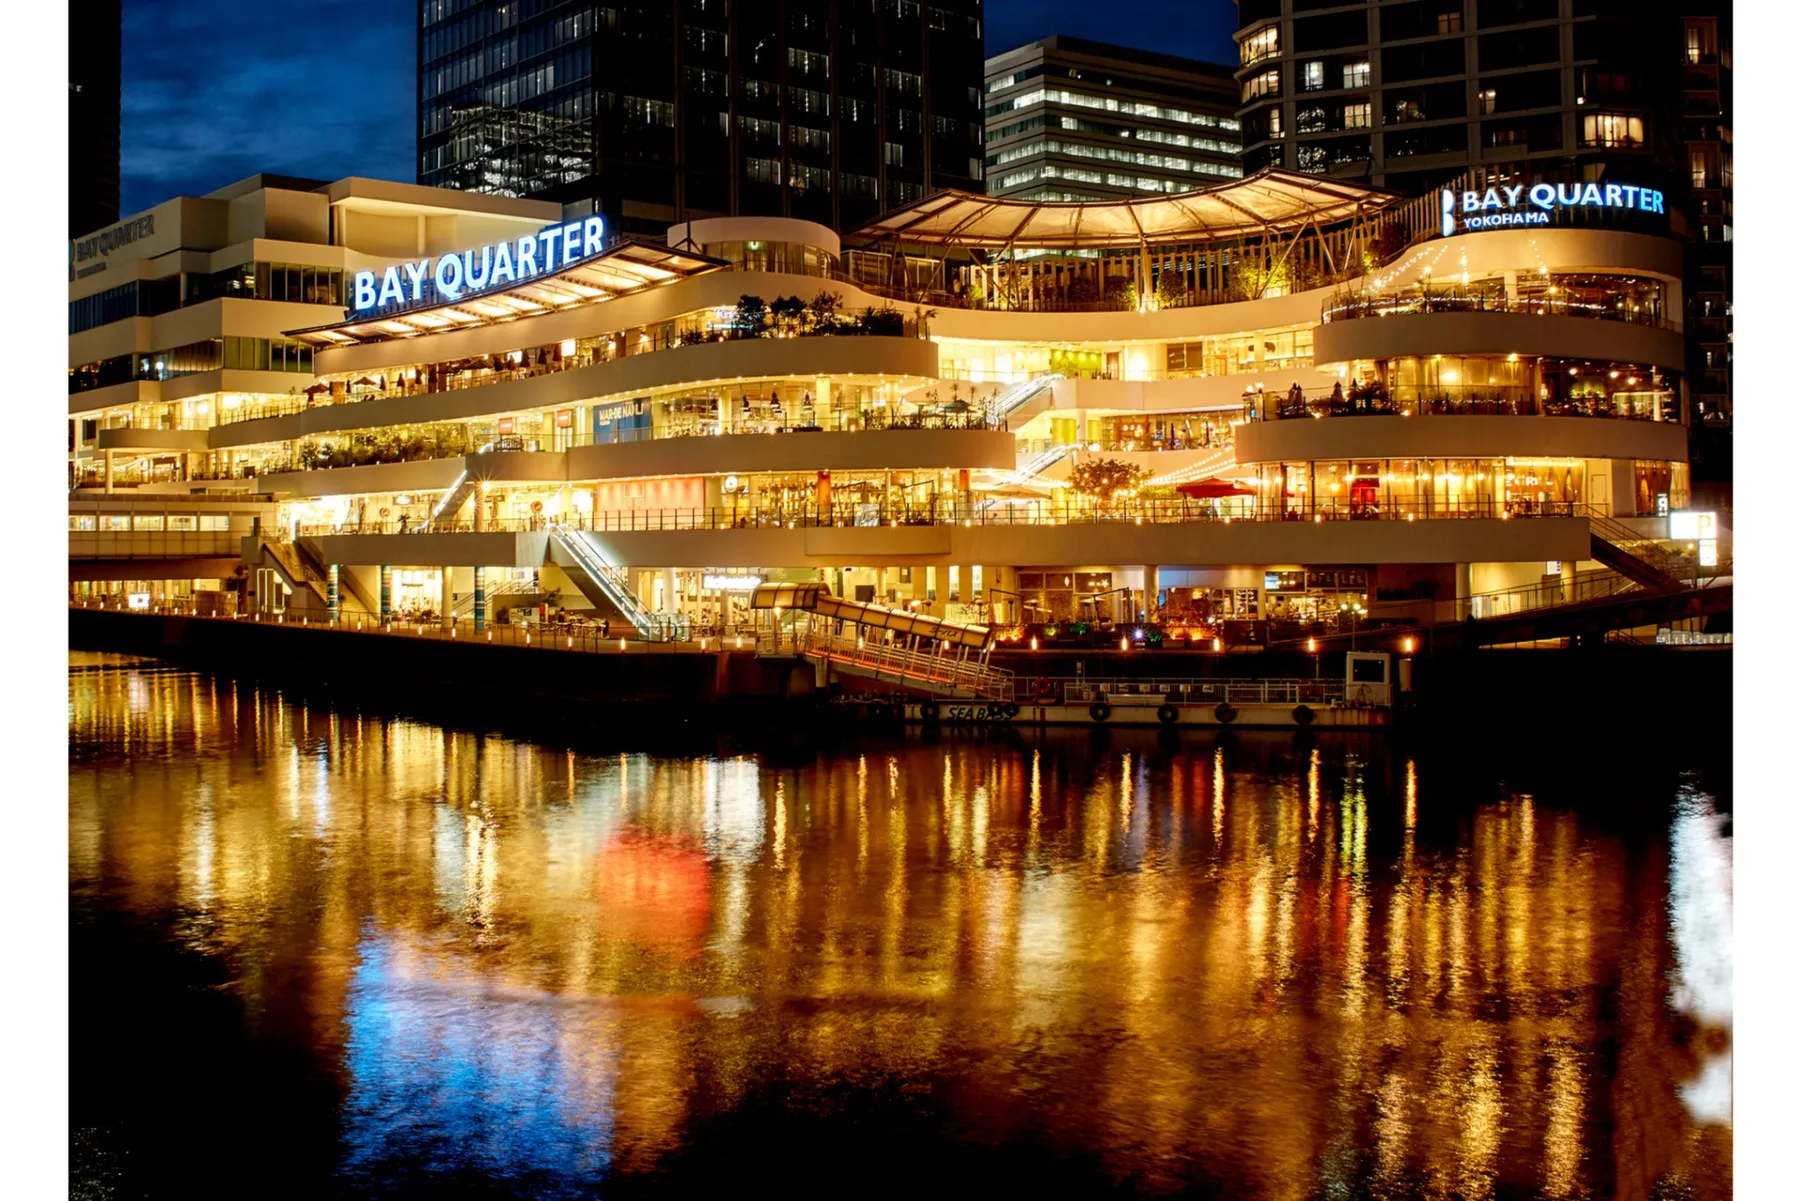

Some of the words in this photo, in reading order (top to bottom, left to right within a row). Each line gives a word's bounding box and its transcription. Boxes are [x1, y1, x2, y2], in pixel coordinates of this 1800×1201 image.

[1463, 185, 1523, 212] BAY
[1529, 183, 1664, 214] QUARTER
[1463, 212, 1549, 228] YOKOHAMA
[354, 259, 429, 310] BAY
[434, 216, 604, 299] QUARTER
[948, 707, 974, 721] SEA
